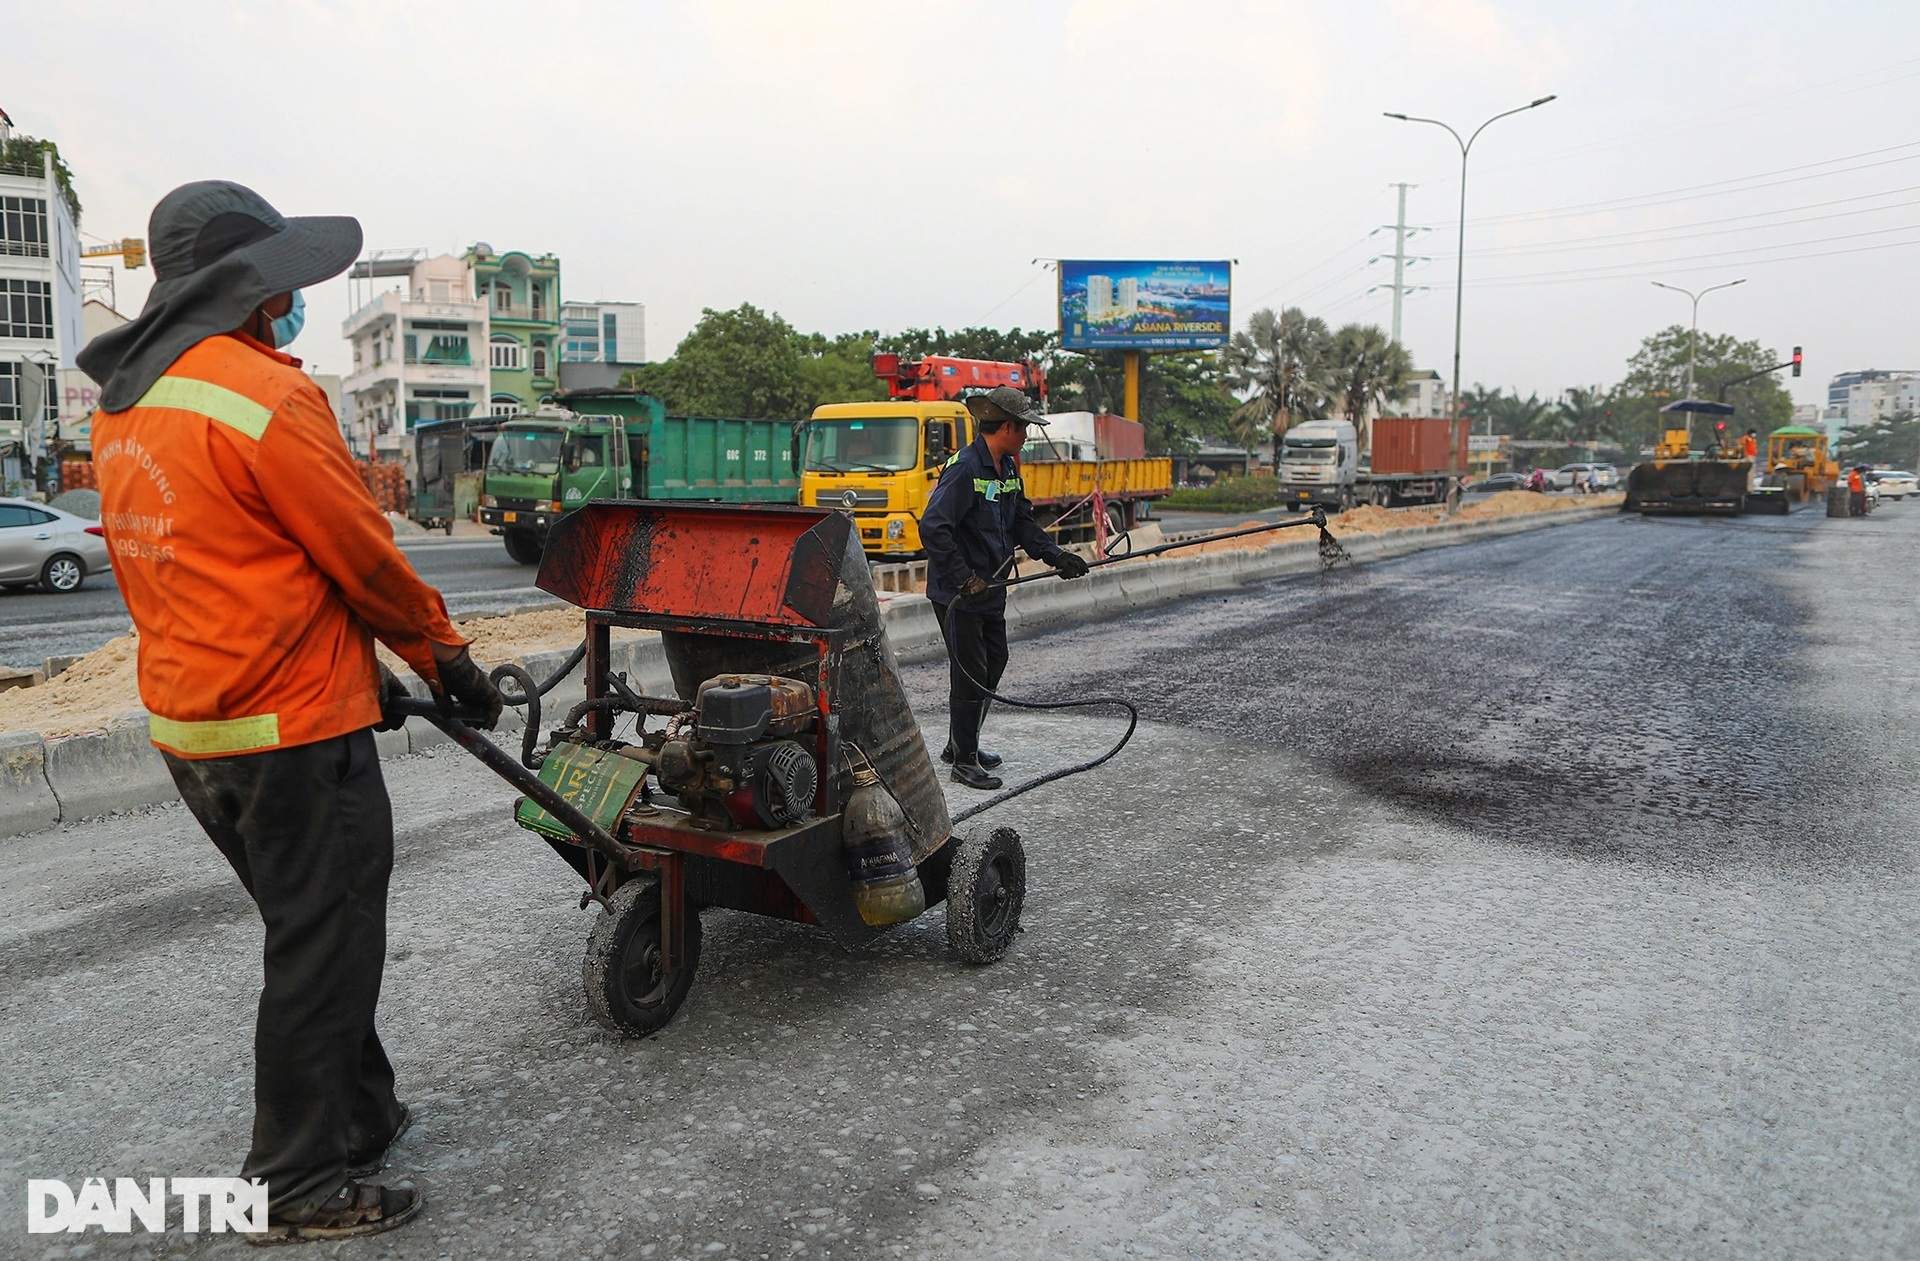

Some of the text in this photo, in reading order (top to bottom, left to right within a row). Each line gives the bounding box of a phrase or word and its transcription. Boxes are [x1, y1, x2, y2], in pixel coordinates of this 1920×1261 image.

[1134, 321, 1222, 332] ASIANA RIVERSIDE
[754, 449, 767, 461] 372
[141, 453, 177, 505] DỰNG
[141, 512, 175, 537] PHÁT
[562, 752, 598, 802] ARU
